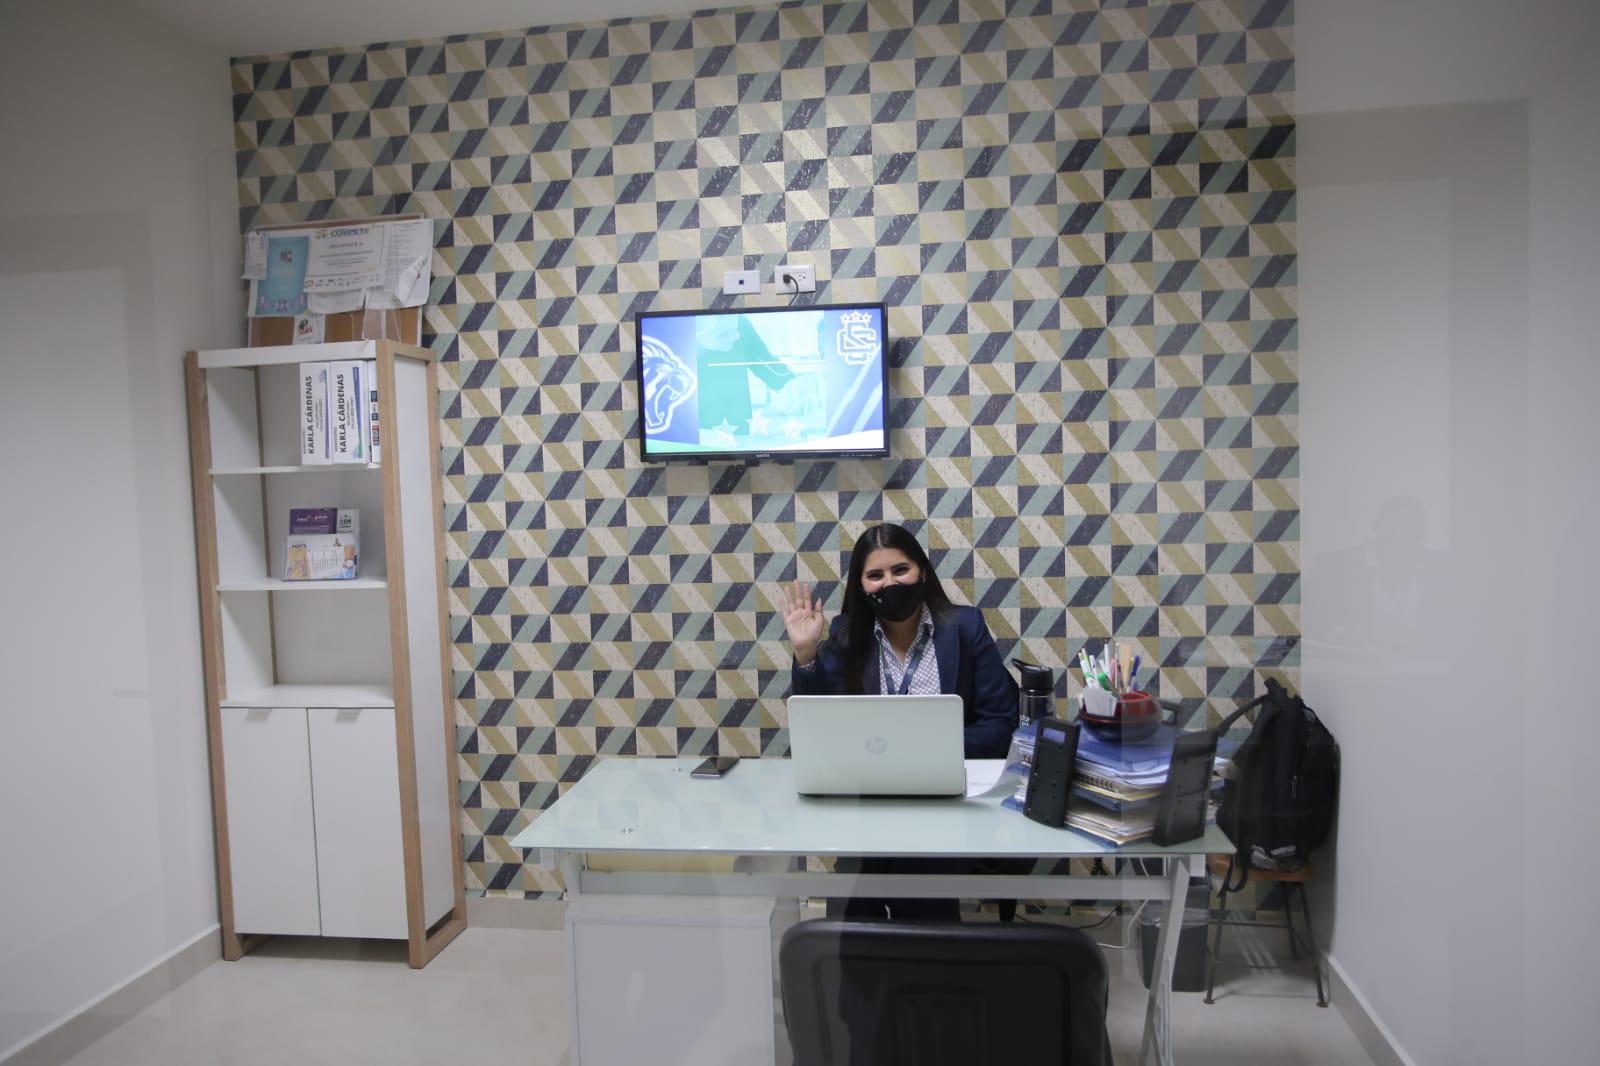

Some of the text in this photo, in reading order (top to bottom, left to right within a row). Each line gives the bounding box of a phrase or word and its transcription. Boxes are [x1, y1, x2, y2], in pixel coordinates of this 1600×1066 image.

[304, 375, 314, 424] CÁRDENAS
[336, 373, 346, 422] CÁRDENAS
[306, 425, 315, 454] KARLA
[338, 423, 347, 453] KARLA
